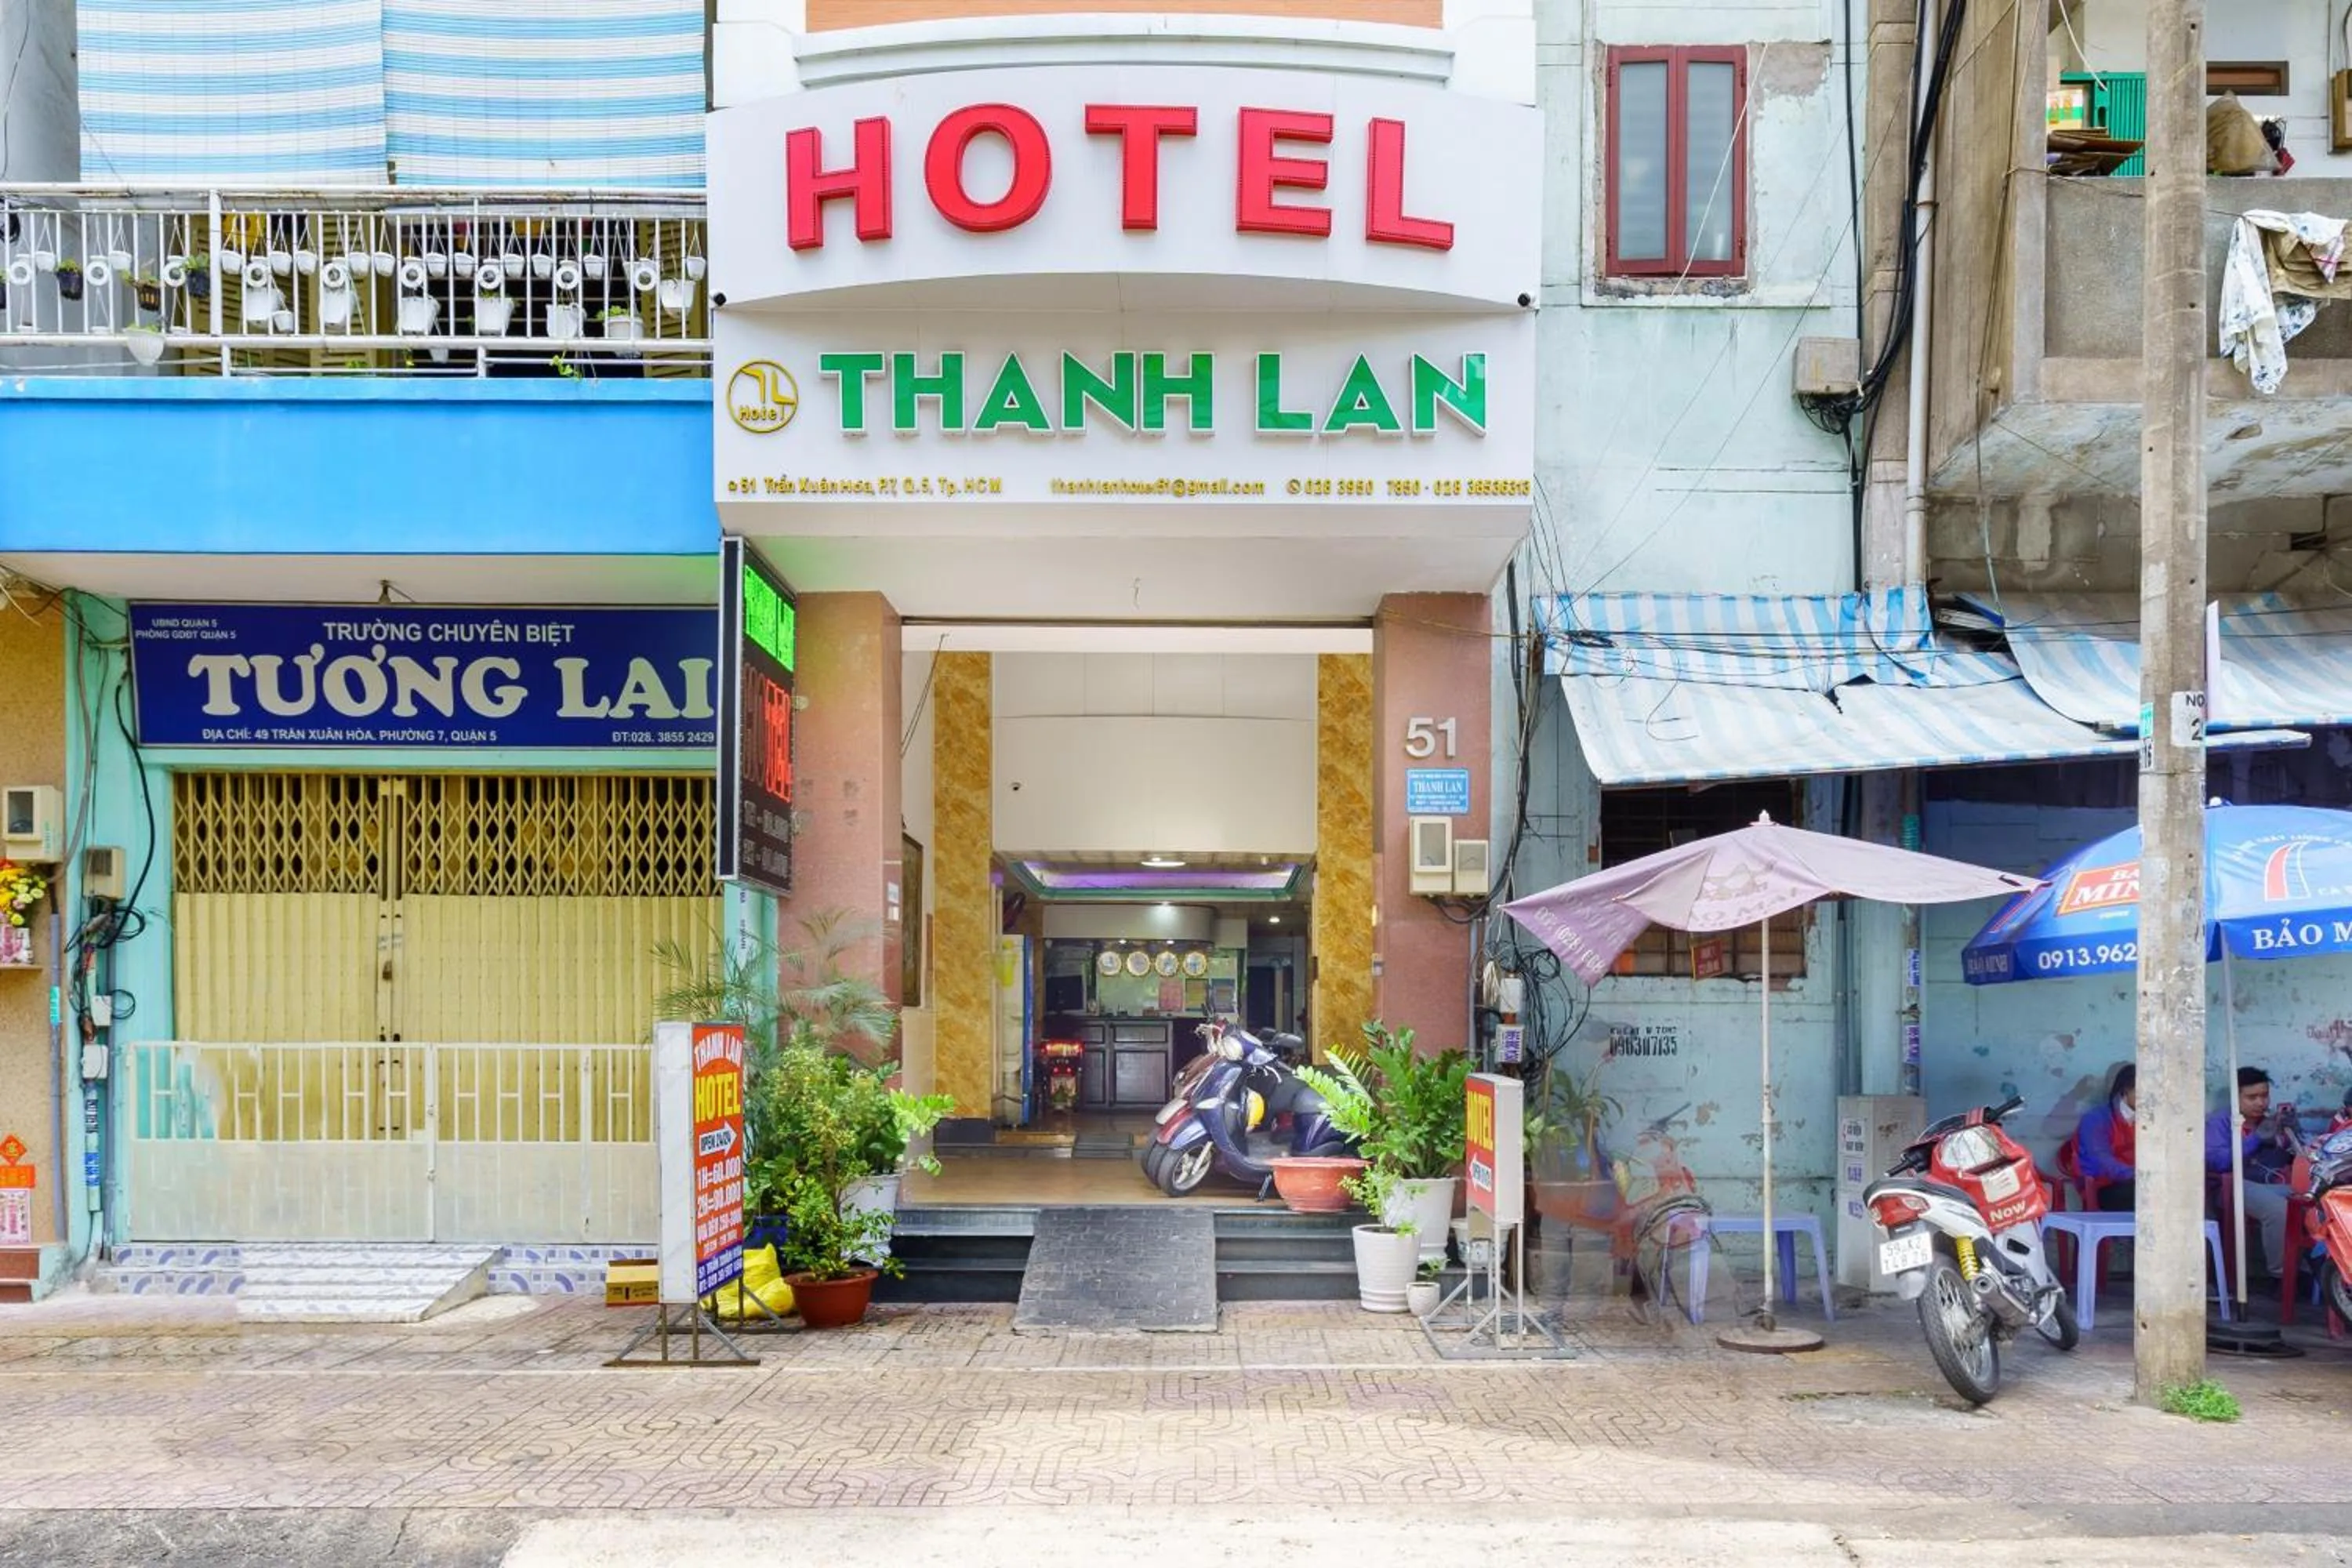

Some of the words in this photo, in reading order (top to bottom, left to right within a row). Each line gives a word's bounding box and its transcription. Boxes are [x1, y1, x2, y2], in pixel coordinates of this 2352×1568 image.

[786, 103, 1454, 251] HOTEL
[818, 351, 1214, 437] THANH
[1255, 351, 1486, 437] LAN
[740, 477, 757, 495] 51
[1305, 477, 1331, 495] 028
[230, 630, 237, 639] 5
[323, 618, 422, 641] TRƯỜNG
[428, 619, 519, 642] CHUYÊN
[526, 622, 575, 647] BIỆT
[187, 643, 528, 719] TƯƠNG
[554, 658, 713, 719] LAI
[202, 728, 224, 744] ĐỊA
[254, 729, 269, 740] 49
[309, 728, 344, 741] XUÂN
[379, 728, 435, 742] PHƯỜNG
[437, 730, 448, 743] 7,
[451, 728, 488, 744] QUẬN
[489, 730, 497, 741] 5
[658, 731, 684, 742] 3855
[687, 731, 714, 742] 2429
[1406, 717, 1457, 758] 51
[2070, 880, 2140, 906] MIN
[2252, 918, 2324, 949] BẢO
[2333, 921, 2352, 944] M
[2038, 942, 2139, 970] 0913.962
[694, 1031, 724, 1073] THANH
[725, 1031, 743, 1068] LAN
[695, 1072, 741, 1123] HOTEL
